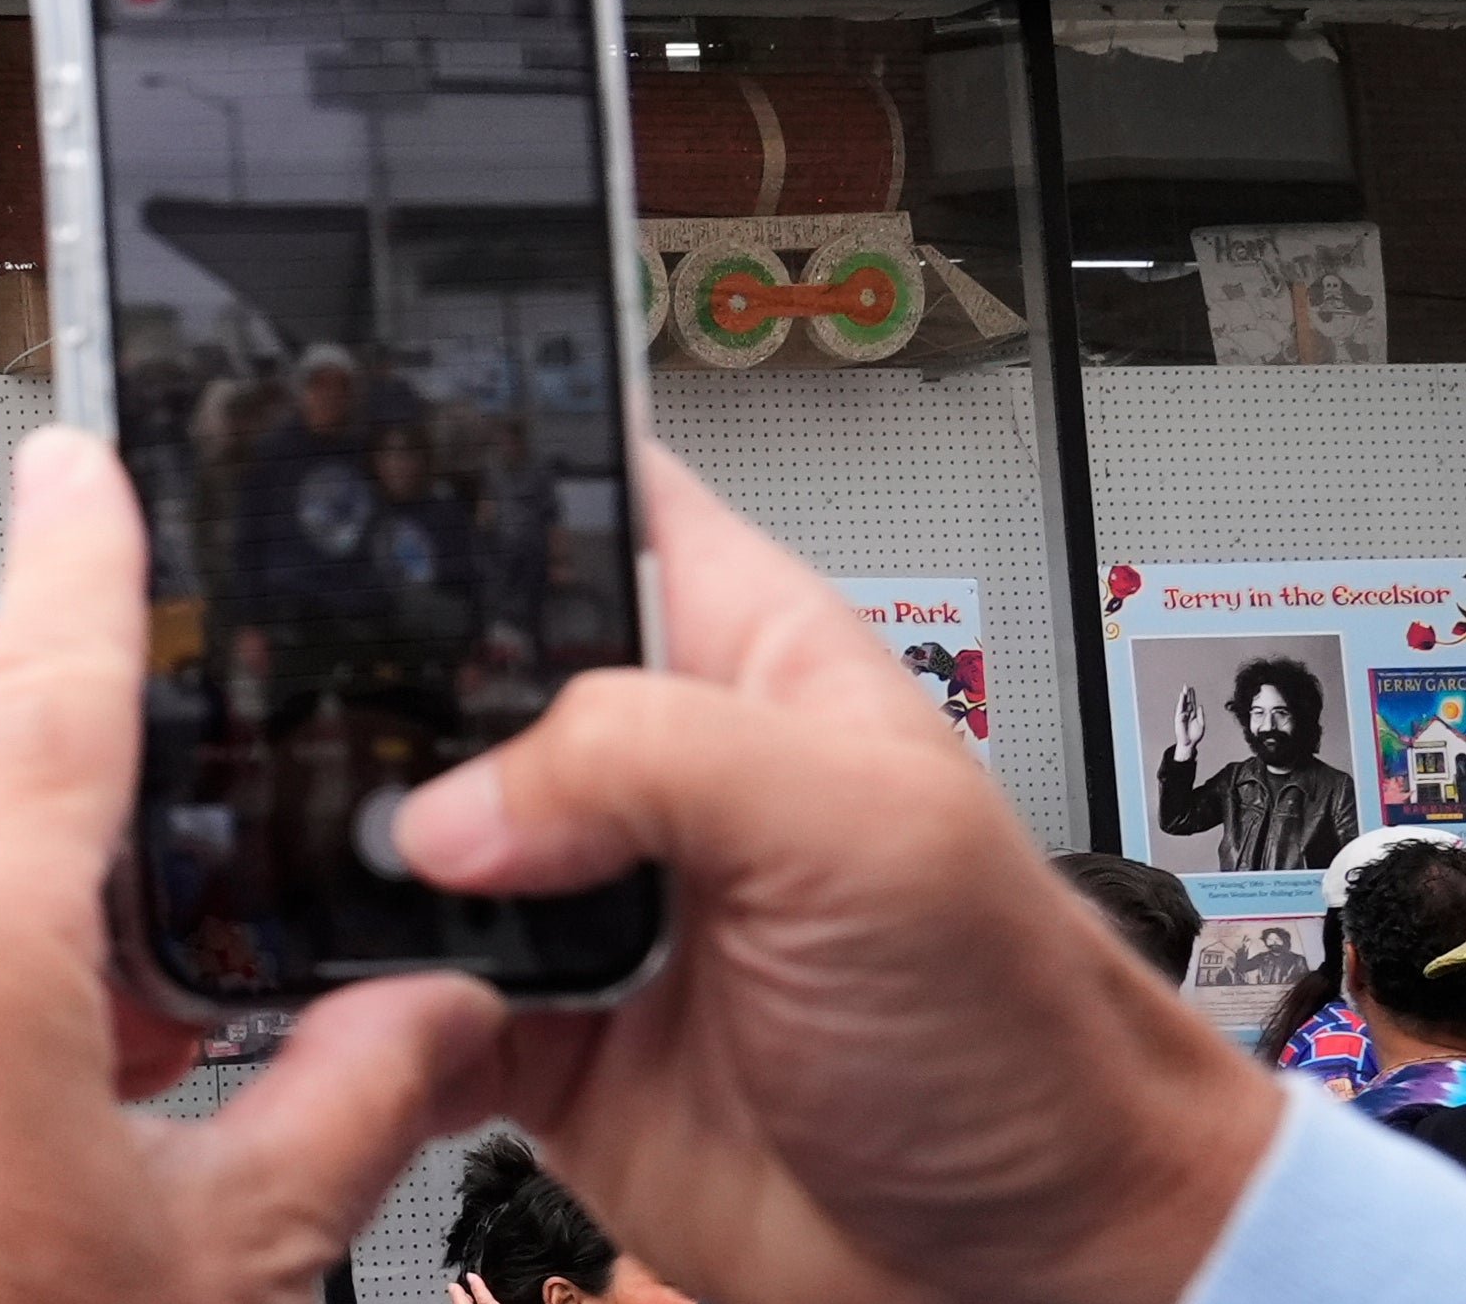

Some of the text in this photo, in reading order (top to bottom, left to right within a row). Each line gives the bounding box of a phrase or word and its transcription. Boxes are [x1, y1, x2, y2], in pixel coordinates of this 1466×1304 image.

[1164, 584, 1450, 611] Jerry in the Excelsior
[894, 601, 960, 624] Park
[1378, 677, 1466, 694] JERRY GARC
